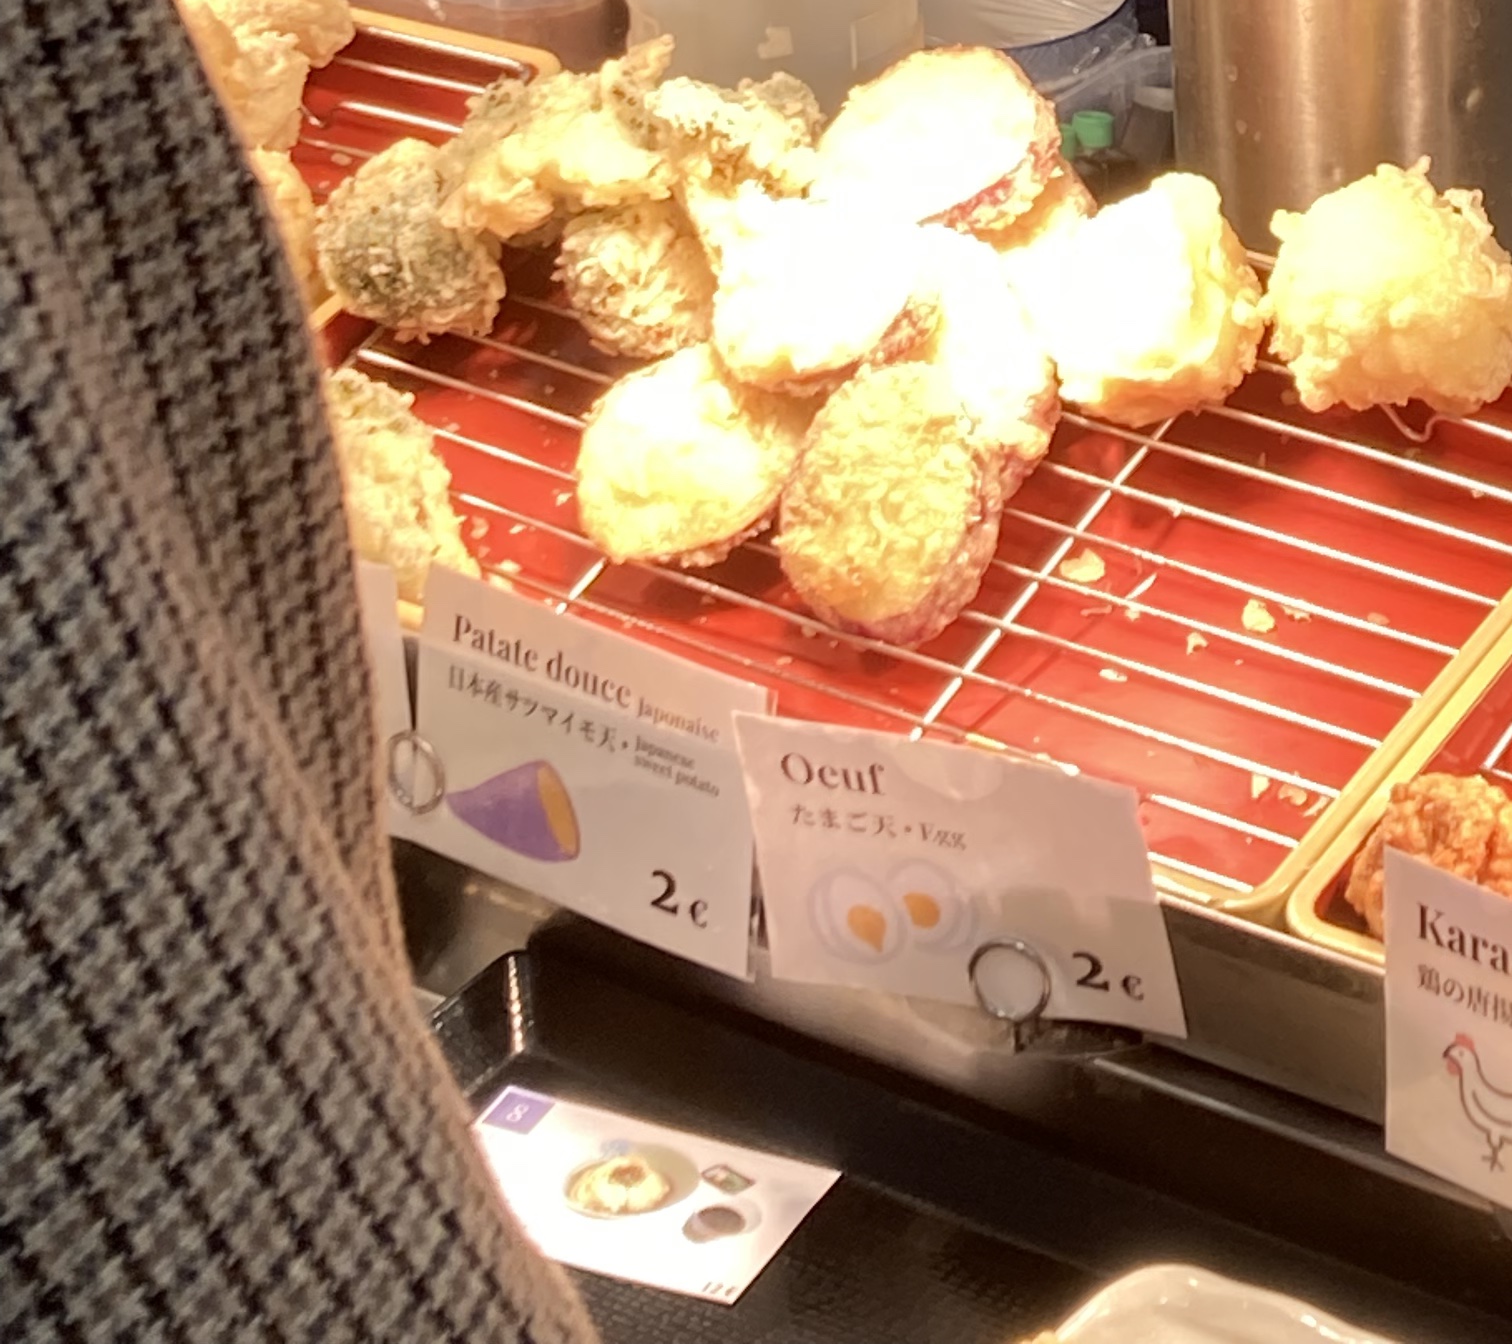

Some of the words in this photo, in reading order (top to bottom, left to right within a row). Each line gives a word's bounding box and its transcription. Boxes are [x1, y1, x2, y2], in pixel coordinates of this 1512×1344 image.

[453, 614, 539, 672] Patate
[546, 650, 631, 709] douce
[781, 752, 886, 796] Oeuf
